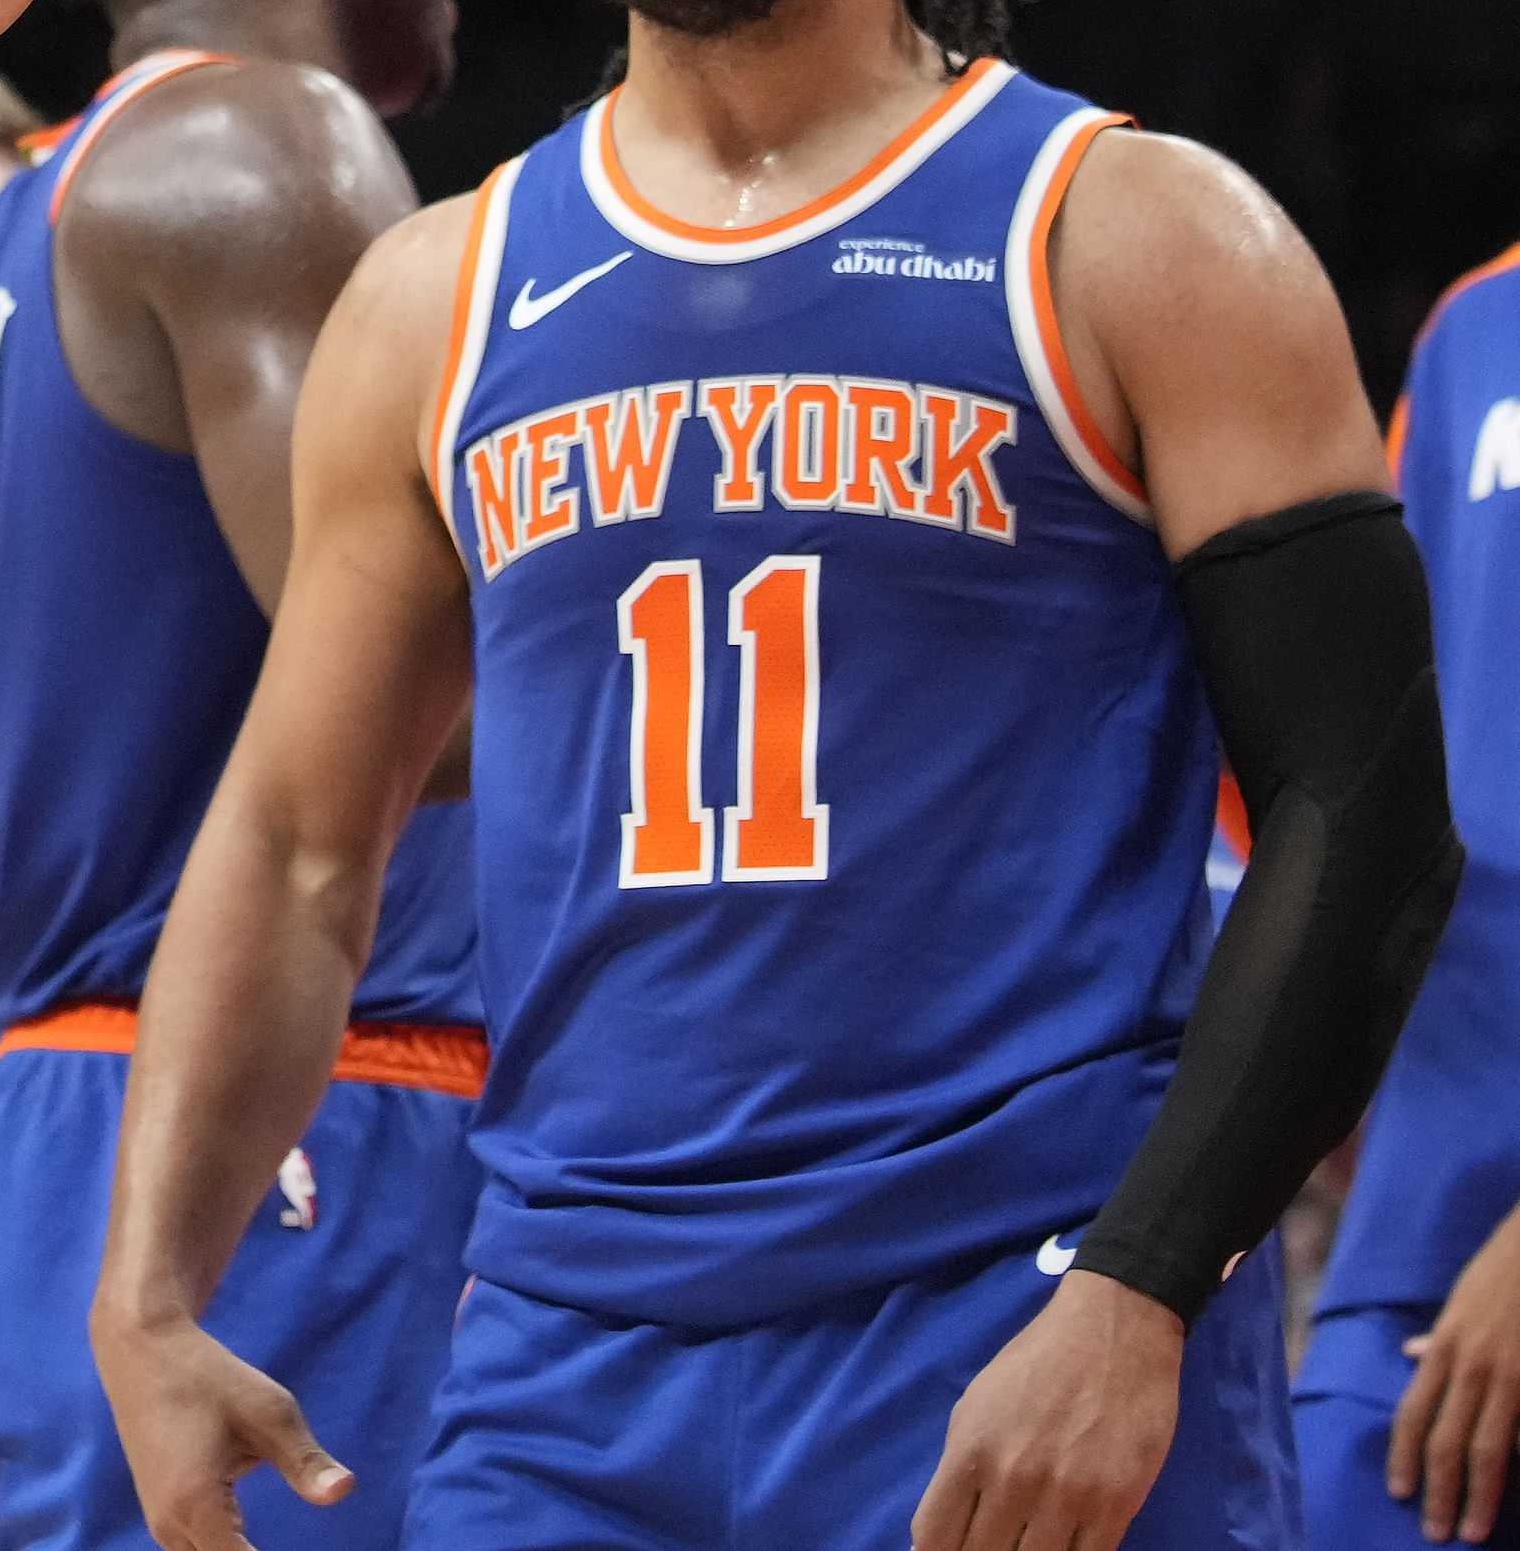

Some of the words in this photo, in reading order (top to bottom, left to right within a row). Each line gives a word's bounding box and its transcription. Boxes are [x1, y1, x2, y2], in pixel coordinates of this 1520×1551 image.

[832, 252, 897, 276] abu
[900, 254, 998, 283] dhabi
[838, 239, 925, 253] experience
[465, 379, 694, 584] NEW
[697, 374, 1018, 546] YORK
[617, 554, 830, 889] 11
